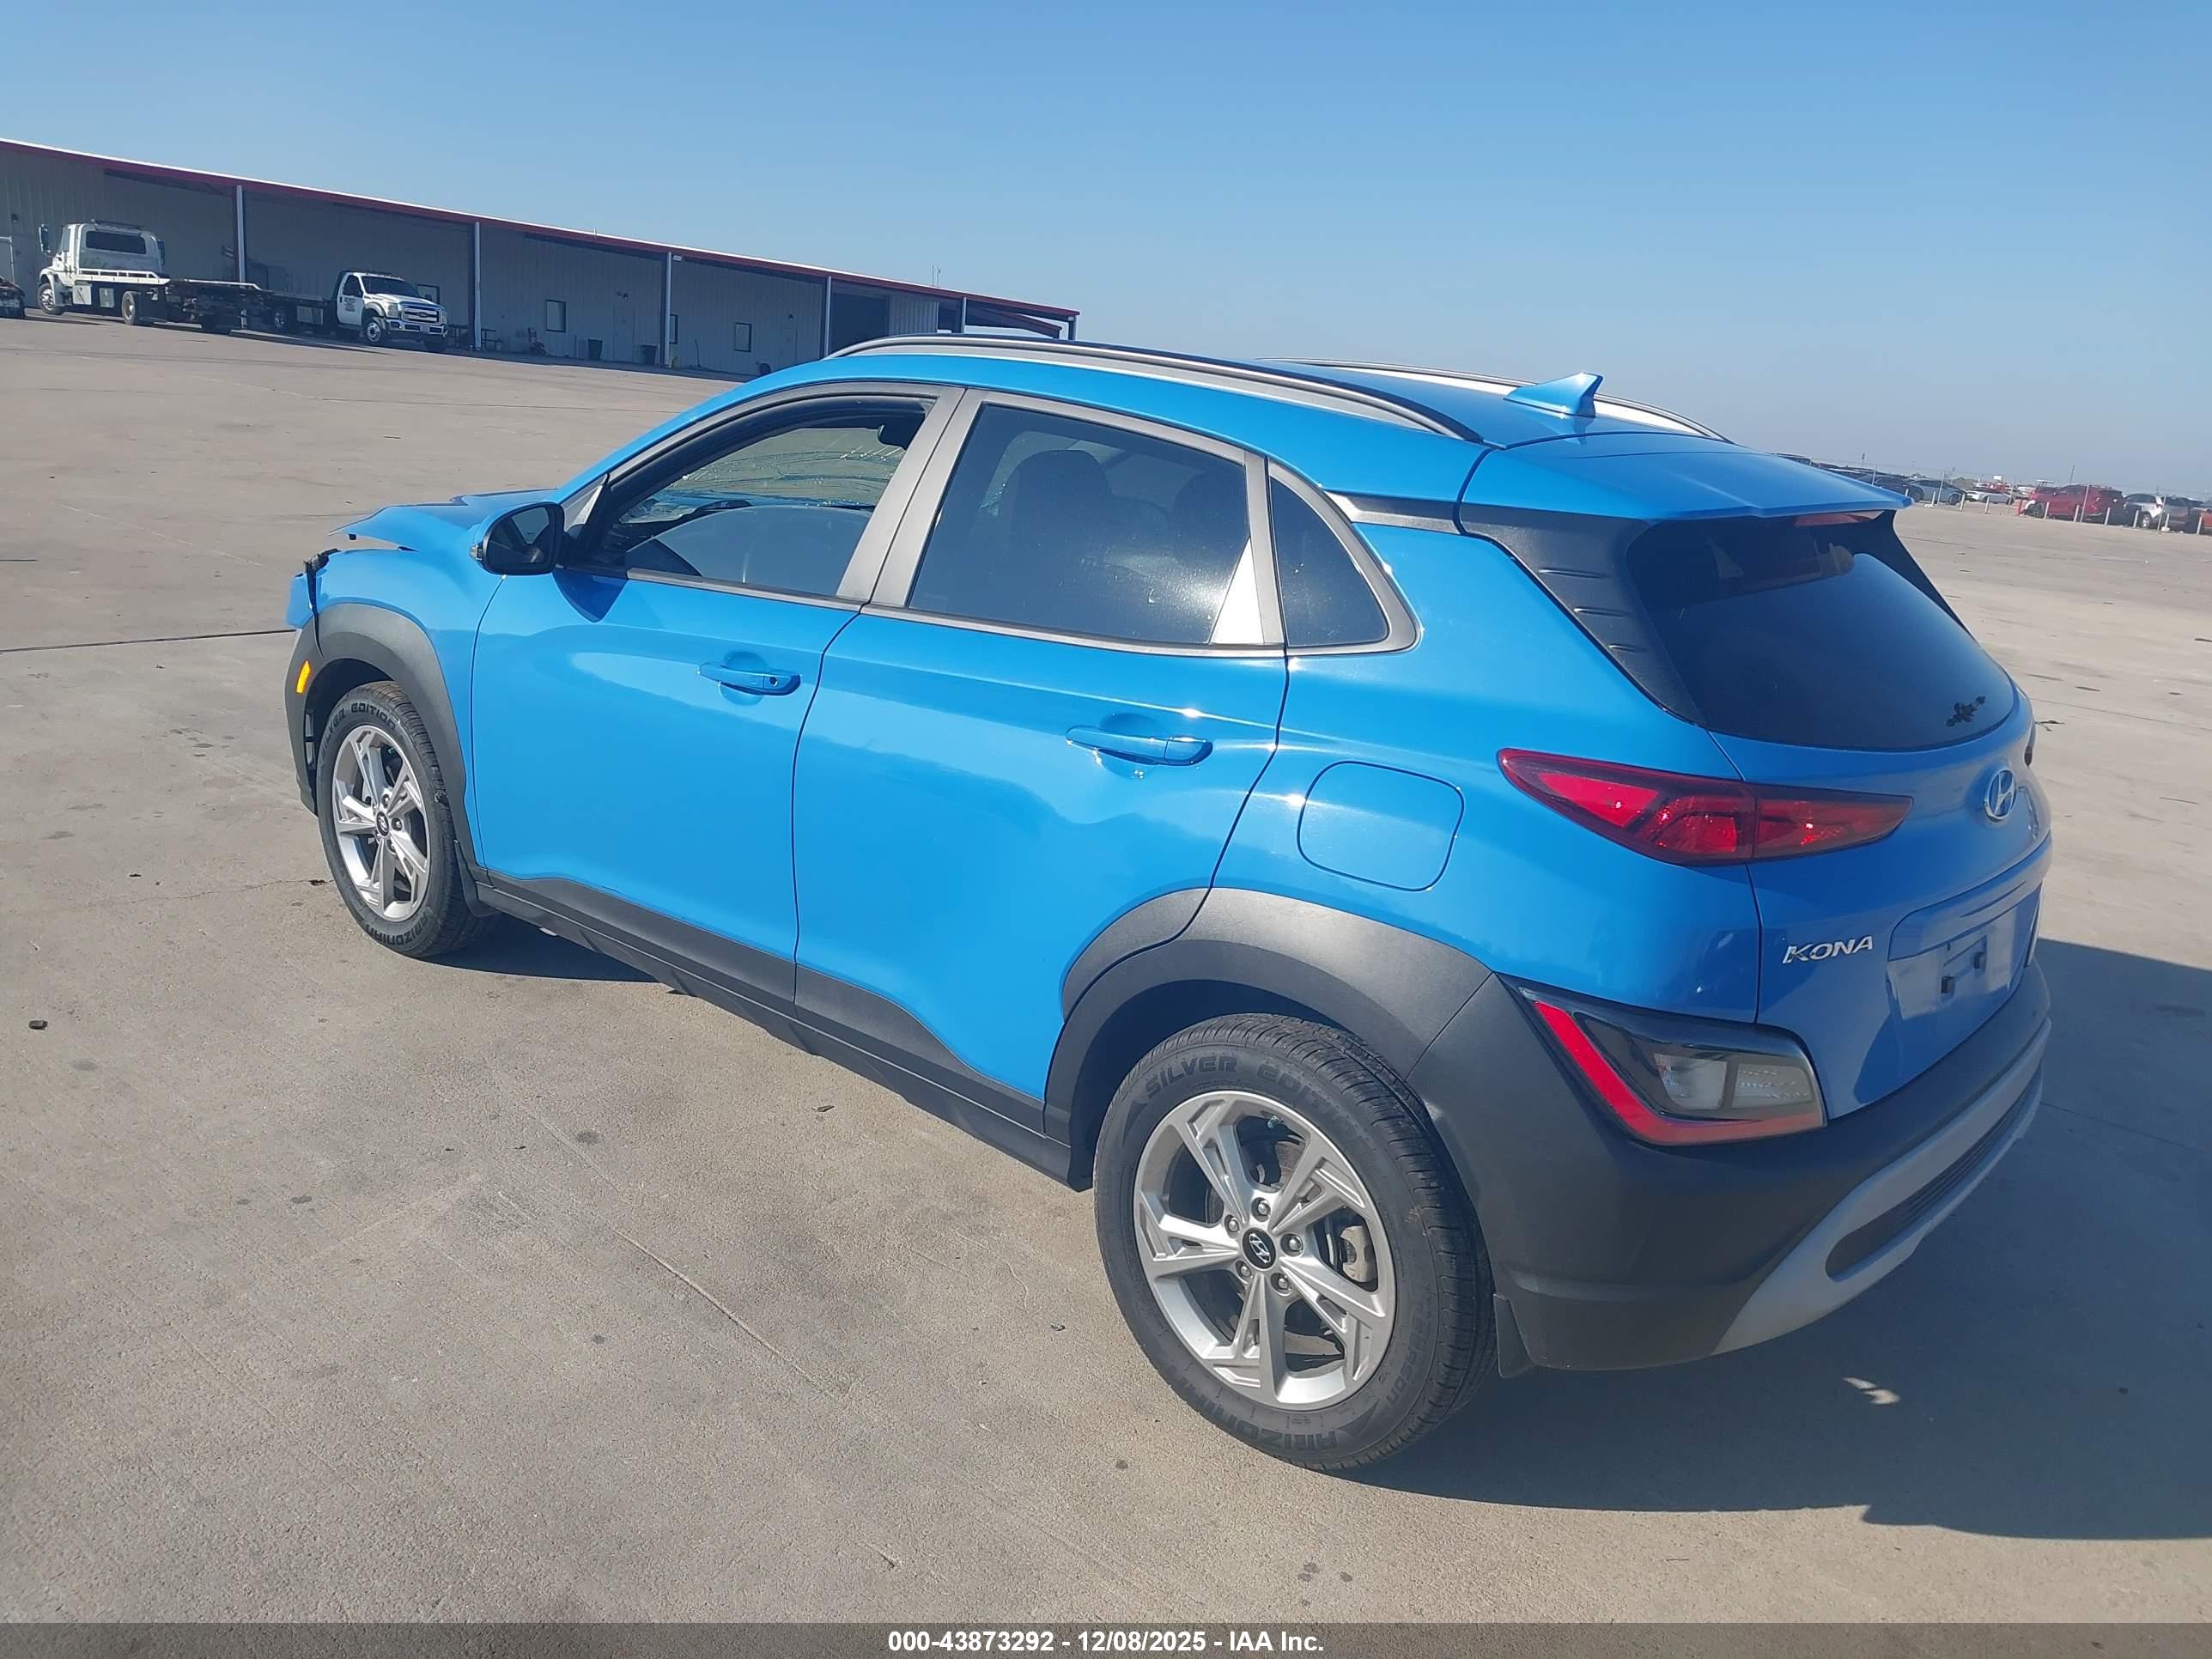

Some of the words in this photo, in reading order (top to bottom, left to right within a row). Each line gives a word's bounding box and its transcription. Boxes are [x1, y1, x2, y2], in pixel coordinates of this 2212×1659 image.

[350, 702, 397, 730] EDITION
[1782, 934, 1874, 964] KONA
[1144, 1055, 1237, 1100] SILVER
